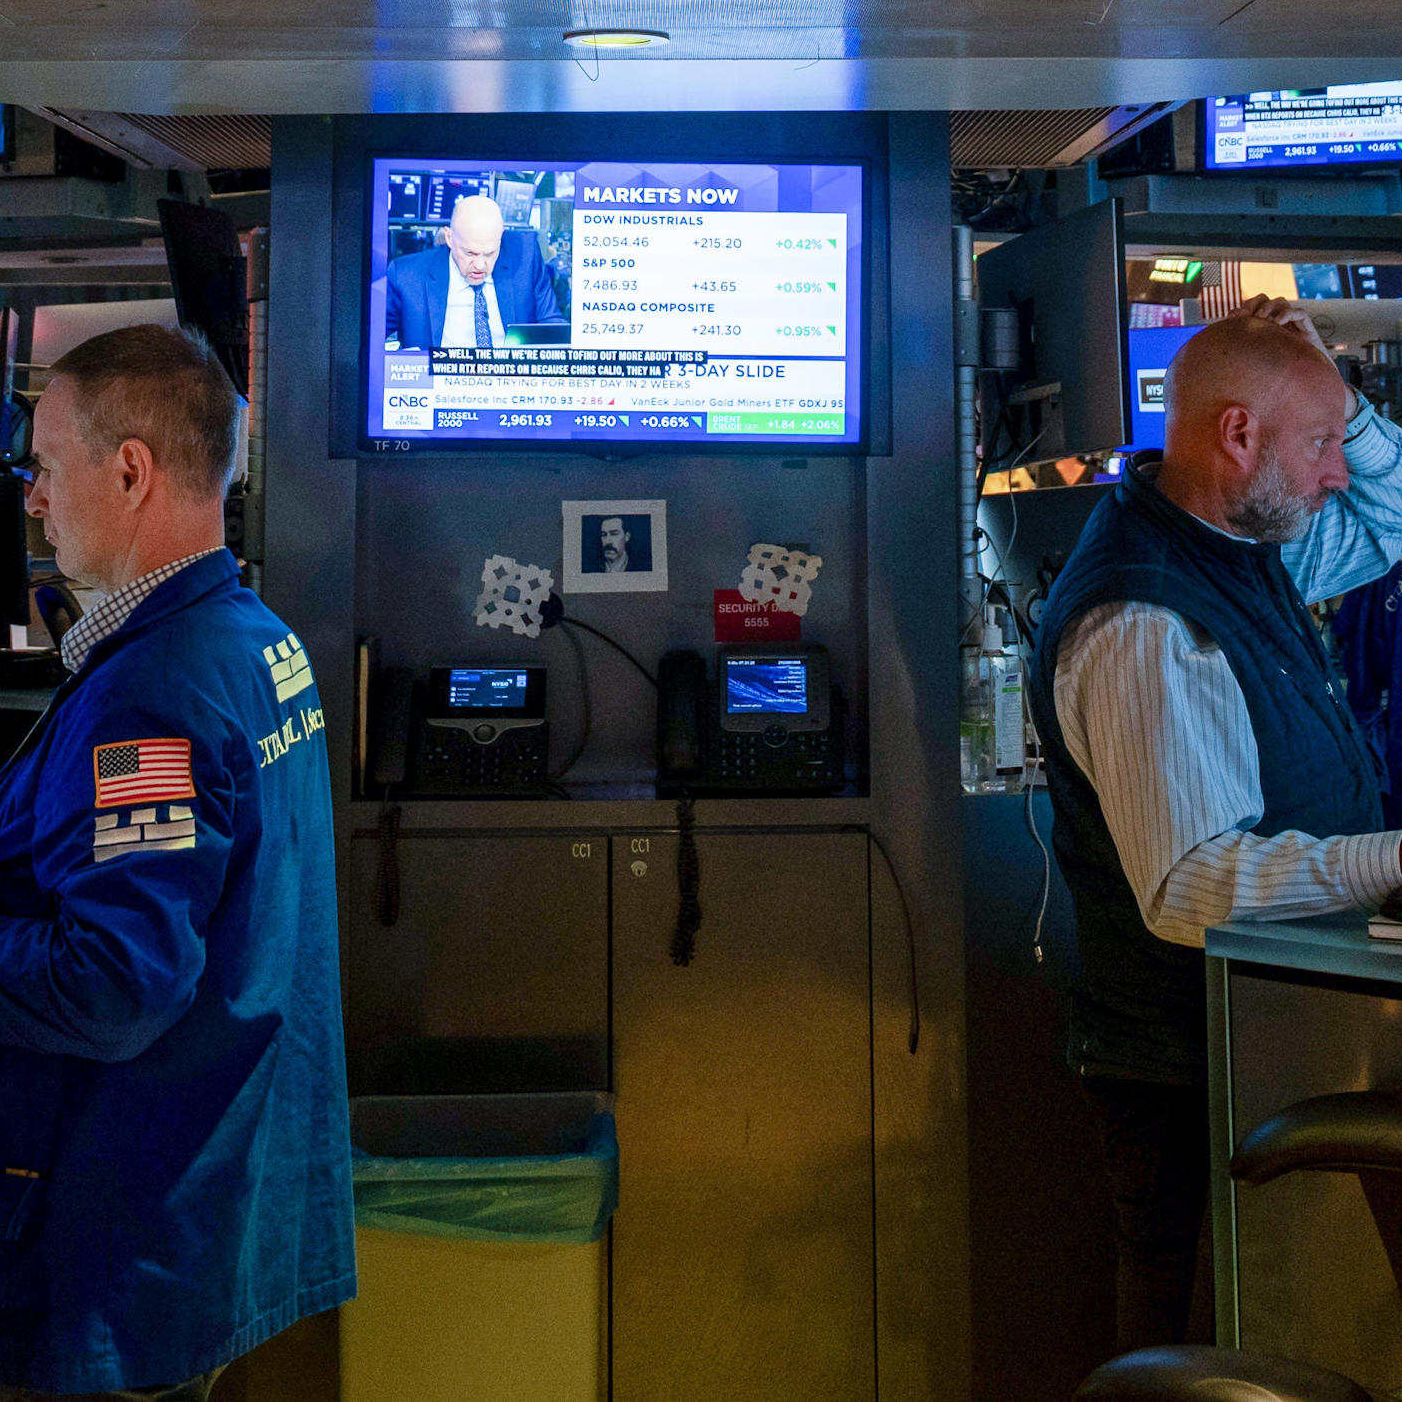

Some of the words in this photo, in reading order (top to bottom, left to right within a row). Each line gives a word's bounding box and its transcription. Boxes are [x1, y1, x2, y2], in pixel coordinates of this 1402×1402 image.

[584, 187, 681, 203] MARKETS
[687, 189, 738, 204] NOW
[585, 215, 614, 224] DOW
[620, 216, 703, 225] INDUSTRIALS
[584, 237, 649, 247] 52,054.46
[694, 238, 741, 248] +215.20
[583, 259, 606, 267] S&P
[611, 259, 635, 267] 500
[583, 302, 635, 311] NASDAQ
[641, 303, 714, 312] COMPOSITE
[448, 349, 473, 360] WELL,
[475, 349, 491, 359] THE
[493, 350, 510, 359] WAY
[514, 350, 538, 360] WE'RE
[540, 350, 566, 360] GOING
[568, 350, 598, 360] TOFIND
[600, 351, 617, 360] OUT
[678, 365, 728, 377] 3-DAY
[736, 365, 785, 377] SLIDE
[389, 397, 428, 407] CNBC
[438, 412, 478, 421] RUSSELL
[500, 415, 551, 427] 2,961.93
[575, 416, 616, 426] +19.50
[641, 416, 689, 427] +0.66%
[438, 419, 463, 428] 2000
[374, 440, 390, 450] TF
[395, 440, 410, 450] 70
[718, 604, 768, 613] SECURITY
[572, 843, 590, 857] CC1
[631, 839, 649, 853] CC1
